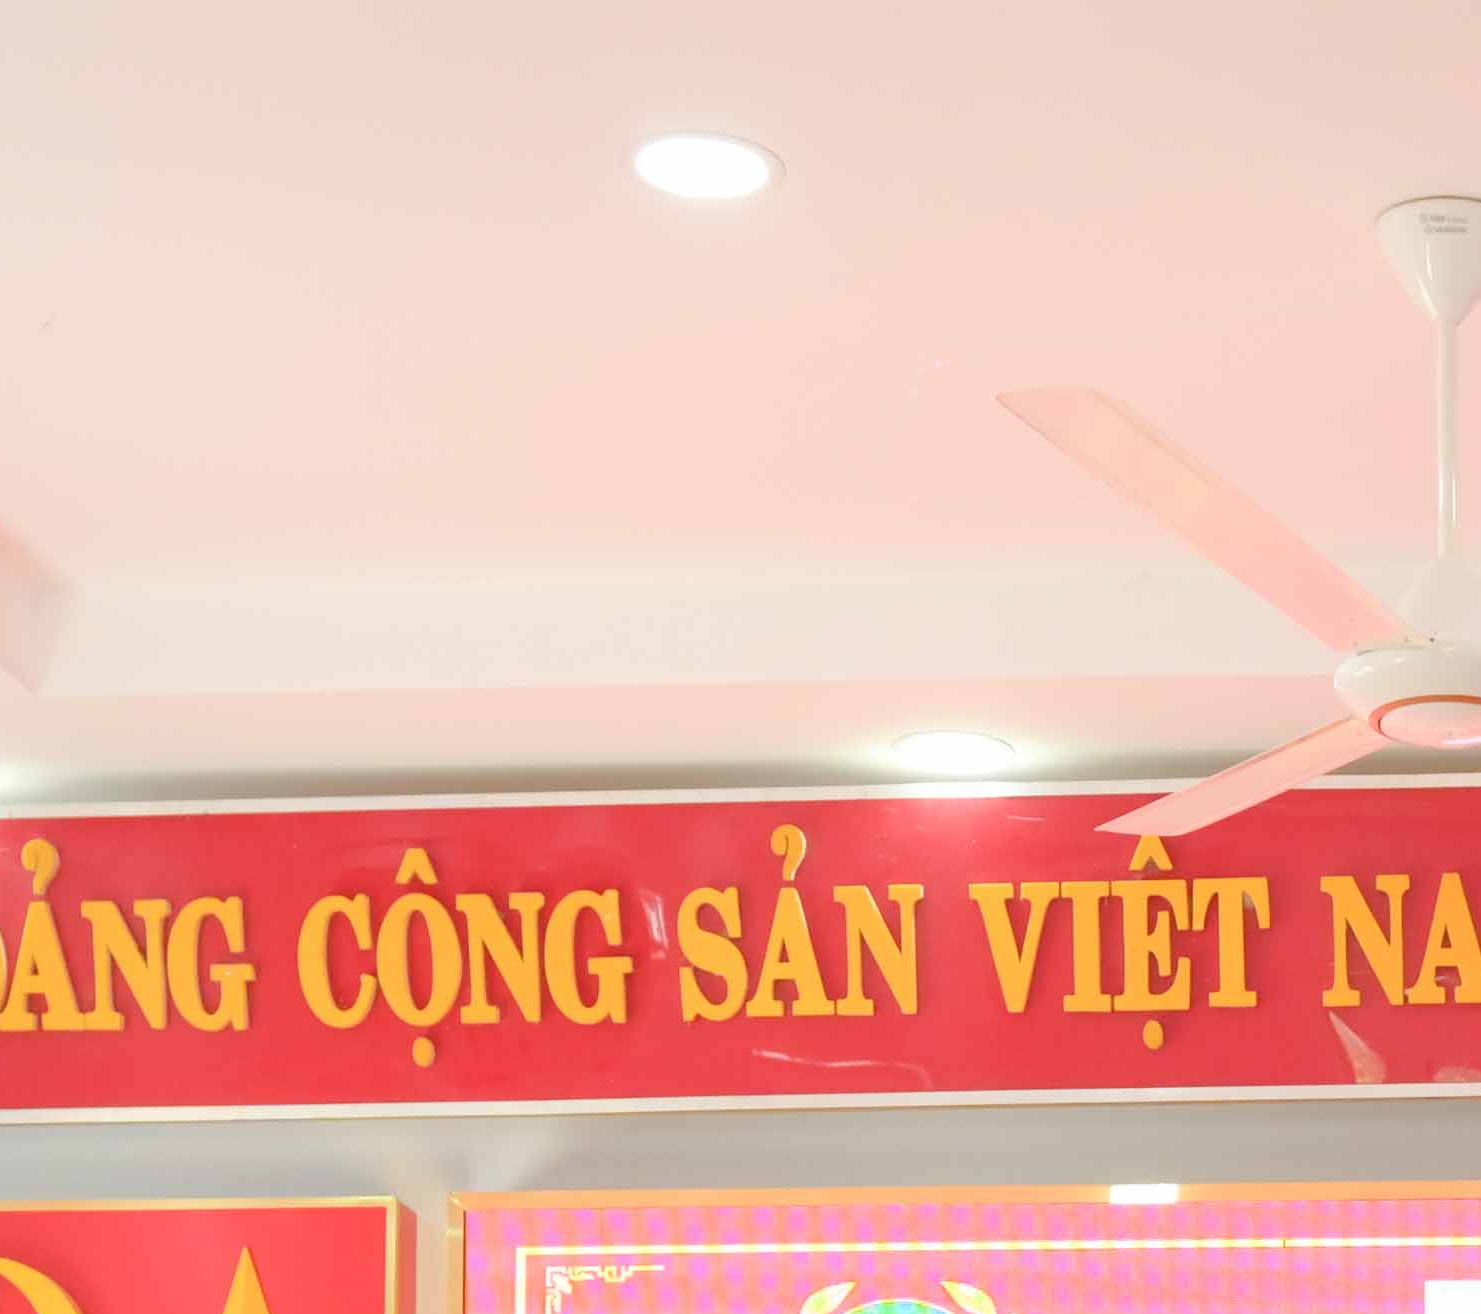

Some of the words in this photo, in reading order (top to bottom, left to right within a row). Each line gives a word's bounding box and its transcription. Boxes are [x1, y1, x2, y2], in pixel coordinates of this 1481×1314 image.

[298, 847, 632, 1068] CỘNG
[680, 825, 924, 1022] SẢN
[969, 835, 1271, 1050] VIỆT
